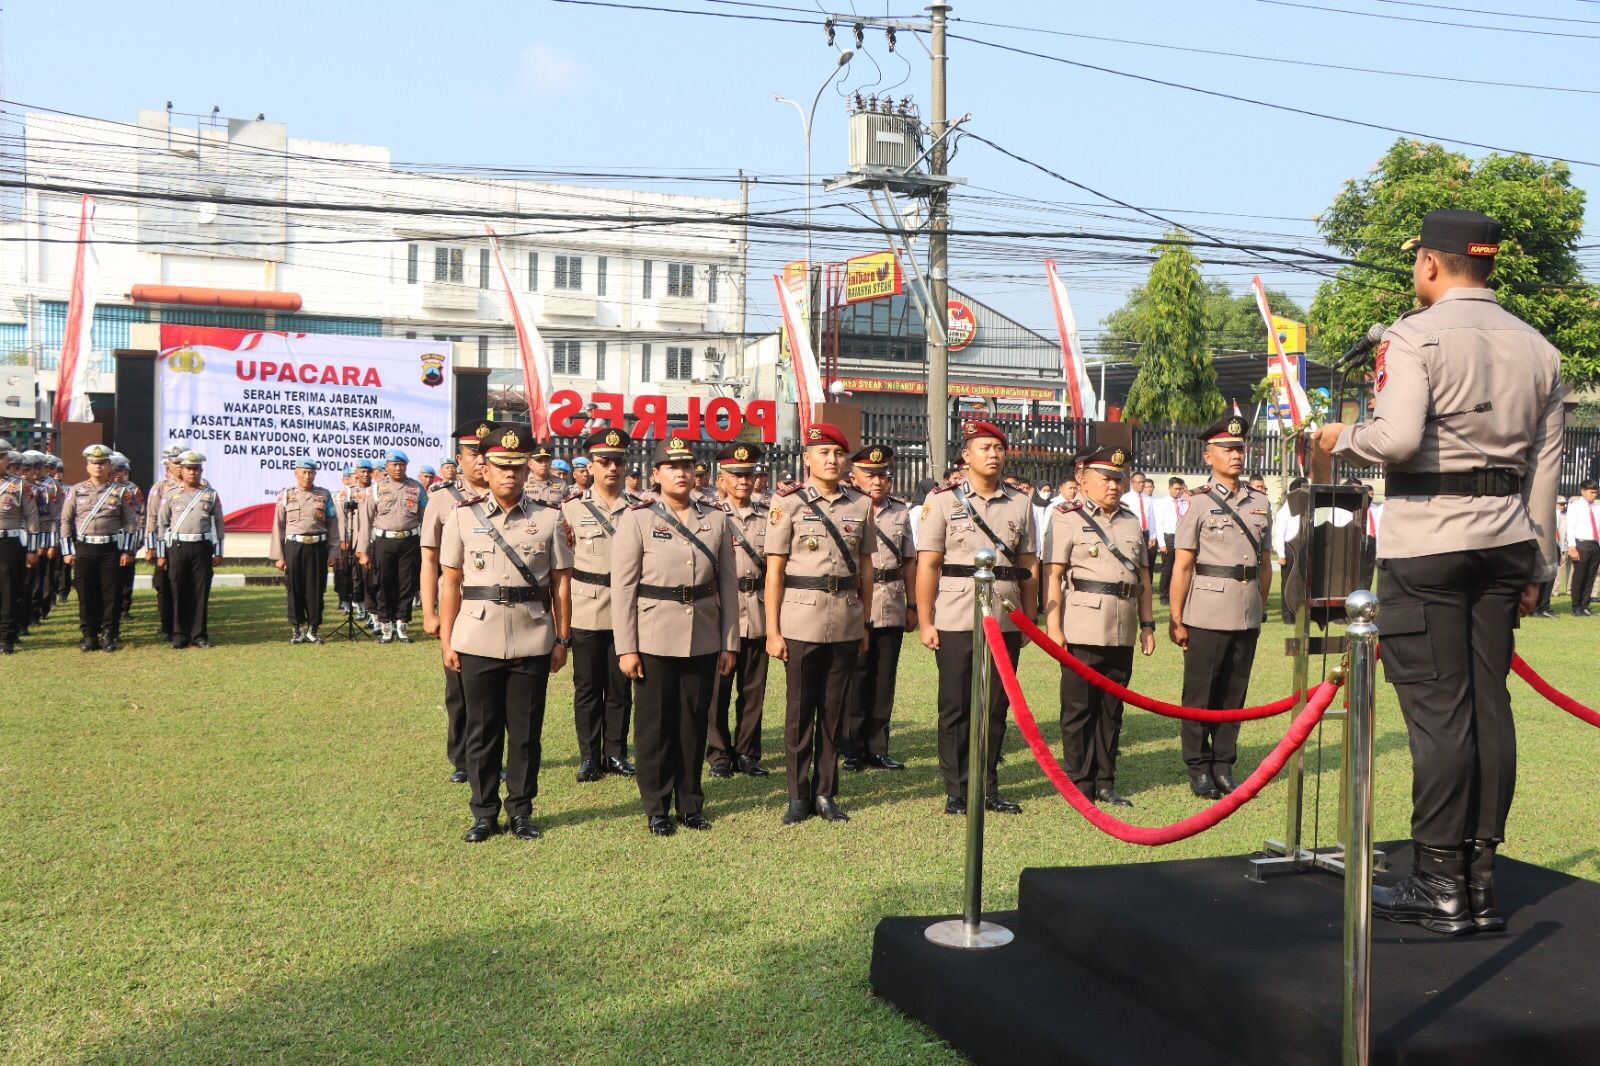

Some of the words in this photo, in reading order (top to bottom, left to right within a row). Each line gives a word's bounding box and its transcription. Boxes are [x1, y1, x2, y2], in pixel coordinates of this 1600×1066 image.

[873, 279, 892, 294] STEAK
[236, 360, 382, 387] UPACARA
[243, 389, 281, 401] SERAH
[284, 391, 325, 403] TERIMA
[329, 393, 378, 405] JABATAN
[223, 402, 305, 417] WAKAPOLRES,
[308, 405, 395, 420] KASATRESKRIM,
[191, 414, 277, 430] KASATLANTAS,
[280, 418, 349, 433] KASIHUMAS,
[352, 421, 424, 436] KASIPROPAM,
[169, 428, 231, 441] KAPOLSEK
[234, 430, 309, 445] BANYUDONO,
[312, 433, 370, 446] KAPOLSEK
[373, 435, 443, 449] MOJOSONGO,
[224, 444, 247, 455] DAN
[251, 445, 311, 457] KAPOLSEK
[317, 447, 387, 459] WONOSEGOR
[260, 459, 297, 470] POLRE
